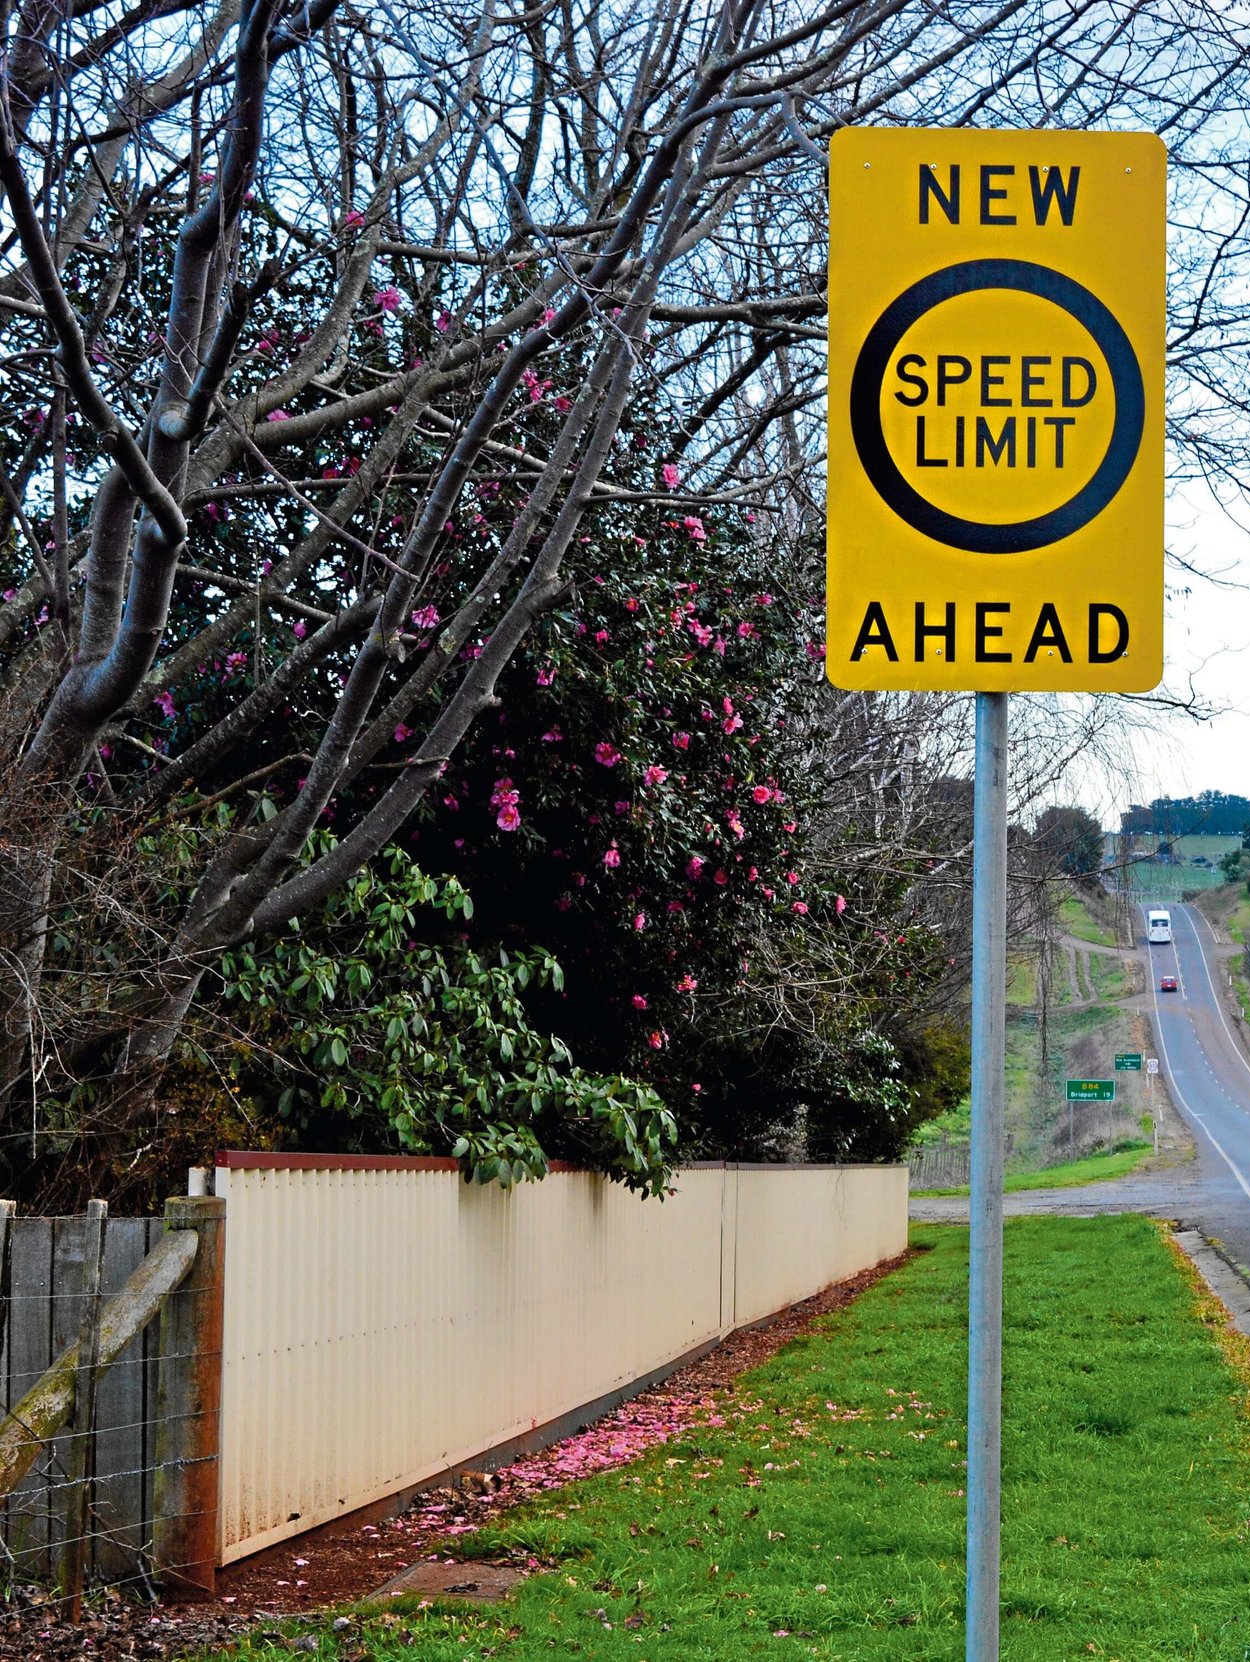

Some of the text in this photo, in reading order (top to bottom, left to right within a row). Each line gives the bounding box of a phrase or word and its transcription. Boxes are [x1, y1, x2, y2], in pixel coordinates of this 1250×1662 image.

[918, 163, 1081, 226] NEW
[893, 353, 1097, 408] SPEED
[916, 415, 1076, 469] LIMIT
[849, 601, 1130, 664] AHEAD
